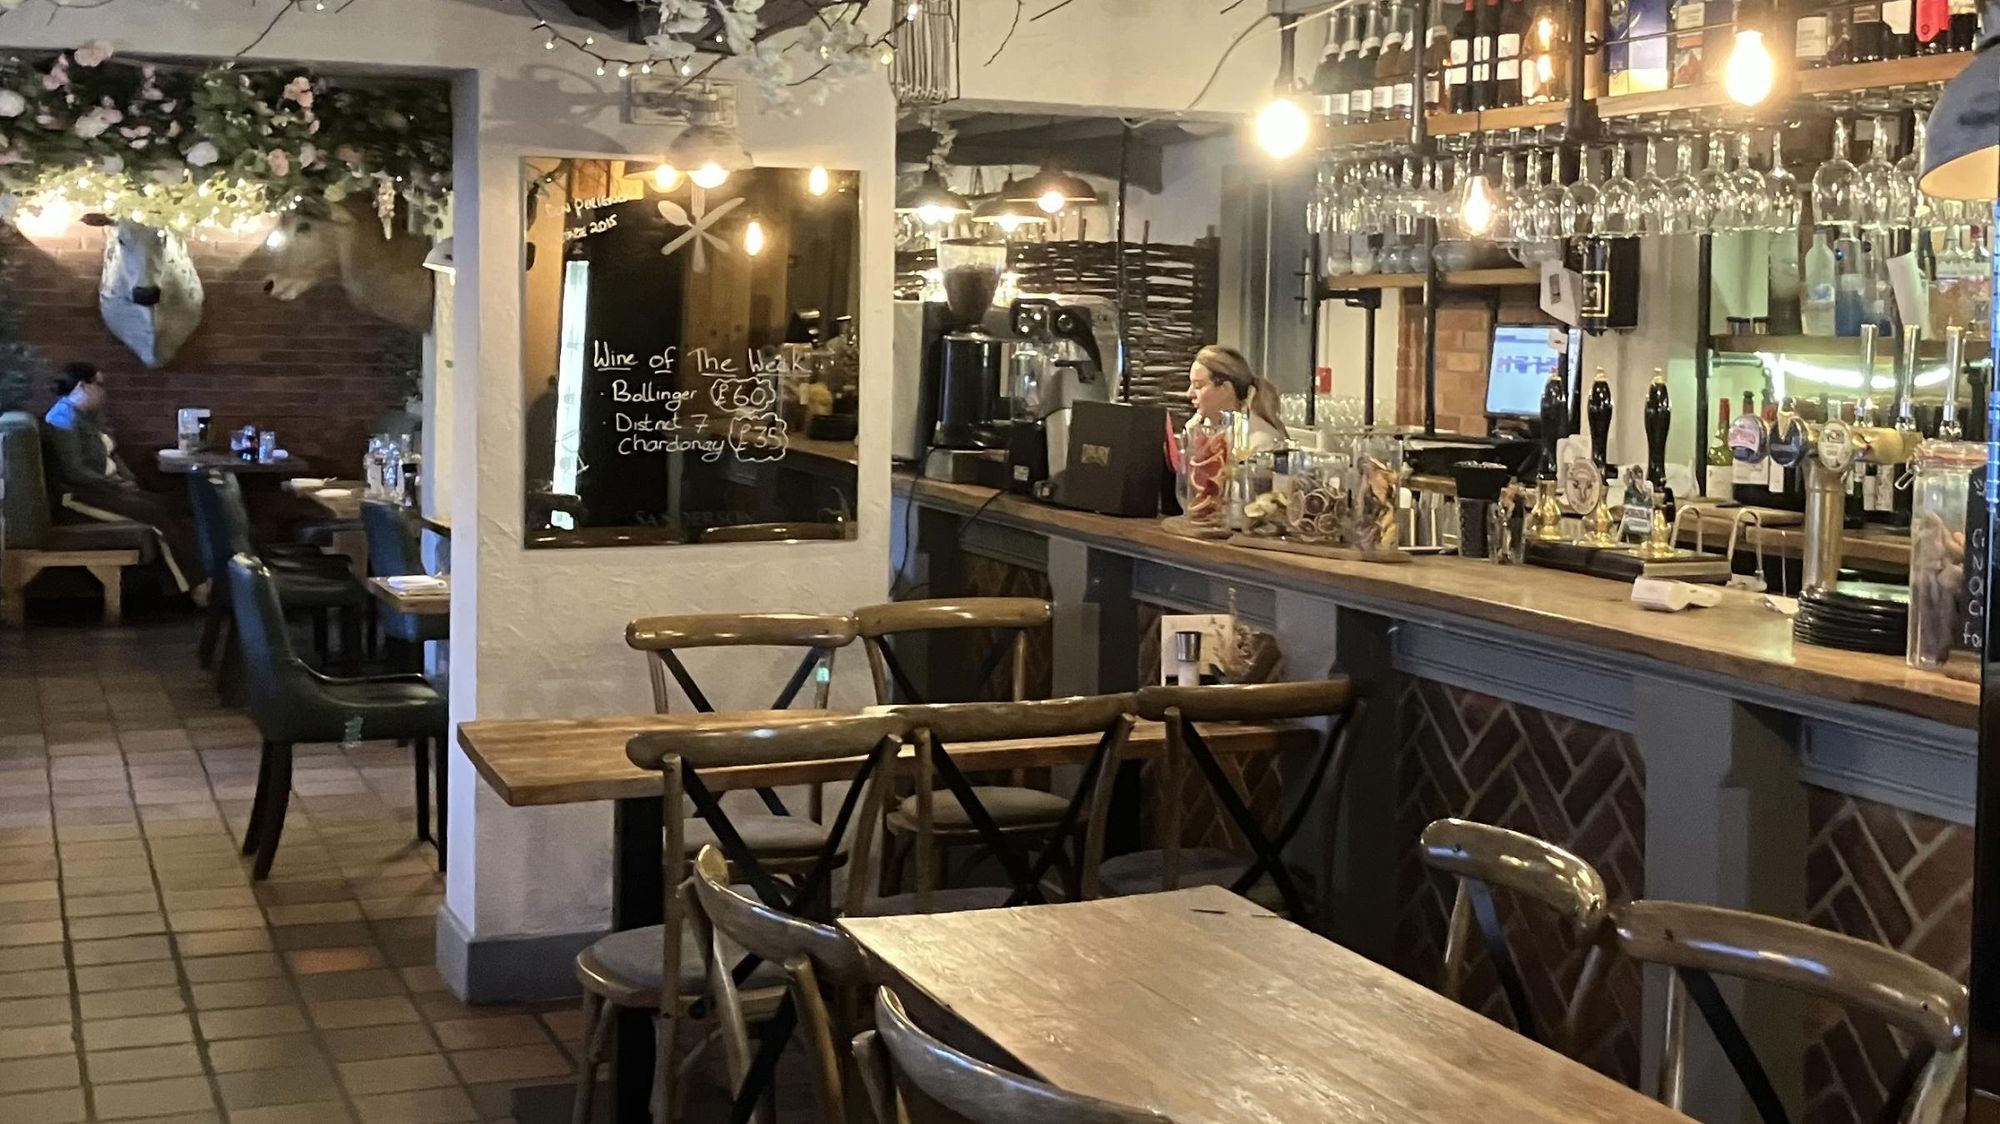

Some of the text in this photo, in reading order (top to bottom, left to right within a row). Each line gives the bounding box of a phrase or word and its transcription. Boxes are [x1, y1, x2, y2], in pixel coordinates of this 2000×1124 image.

[588, 213, 618, 234] 2015
[594, 340, 639, 370] Wine
[648, 345, 676, 373] of
[687, 346, 739, 376] The
[612, 378, 698, 412] Bollinger
[690, 413, 709, 434] 7
